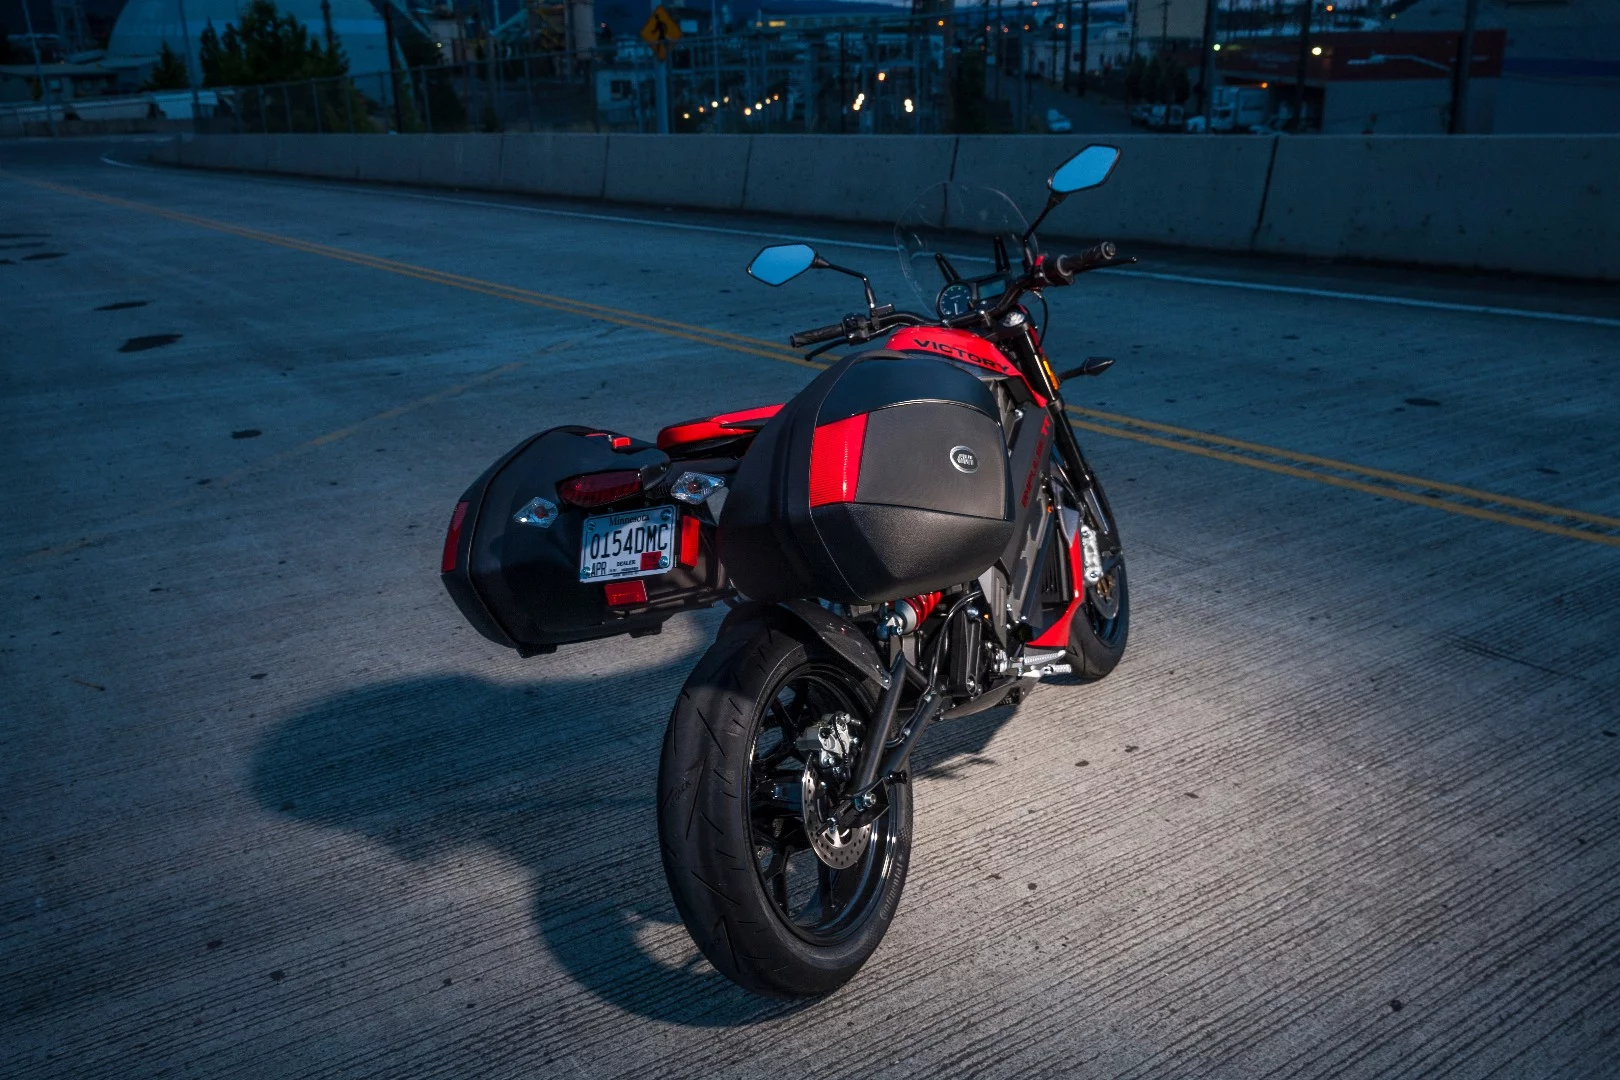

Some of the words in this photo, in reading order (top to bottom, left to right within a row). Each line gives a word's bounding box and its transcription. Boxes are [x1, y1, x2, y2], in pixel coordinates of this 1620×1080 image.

[914, 339, 1009, 373] VICTORY
[611, 515, 649, 525] Minnesota
[591, 524, 668, 559] 0154DMC
[591, 561, 607, 577] APR
[880, 863, 903, 920] Continental
